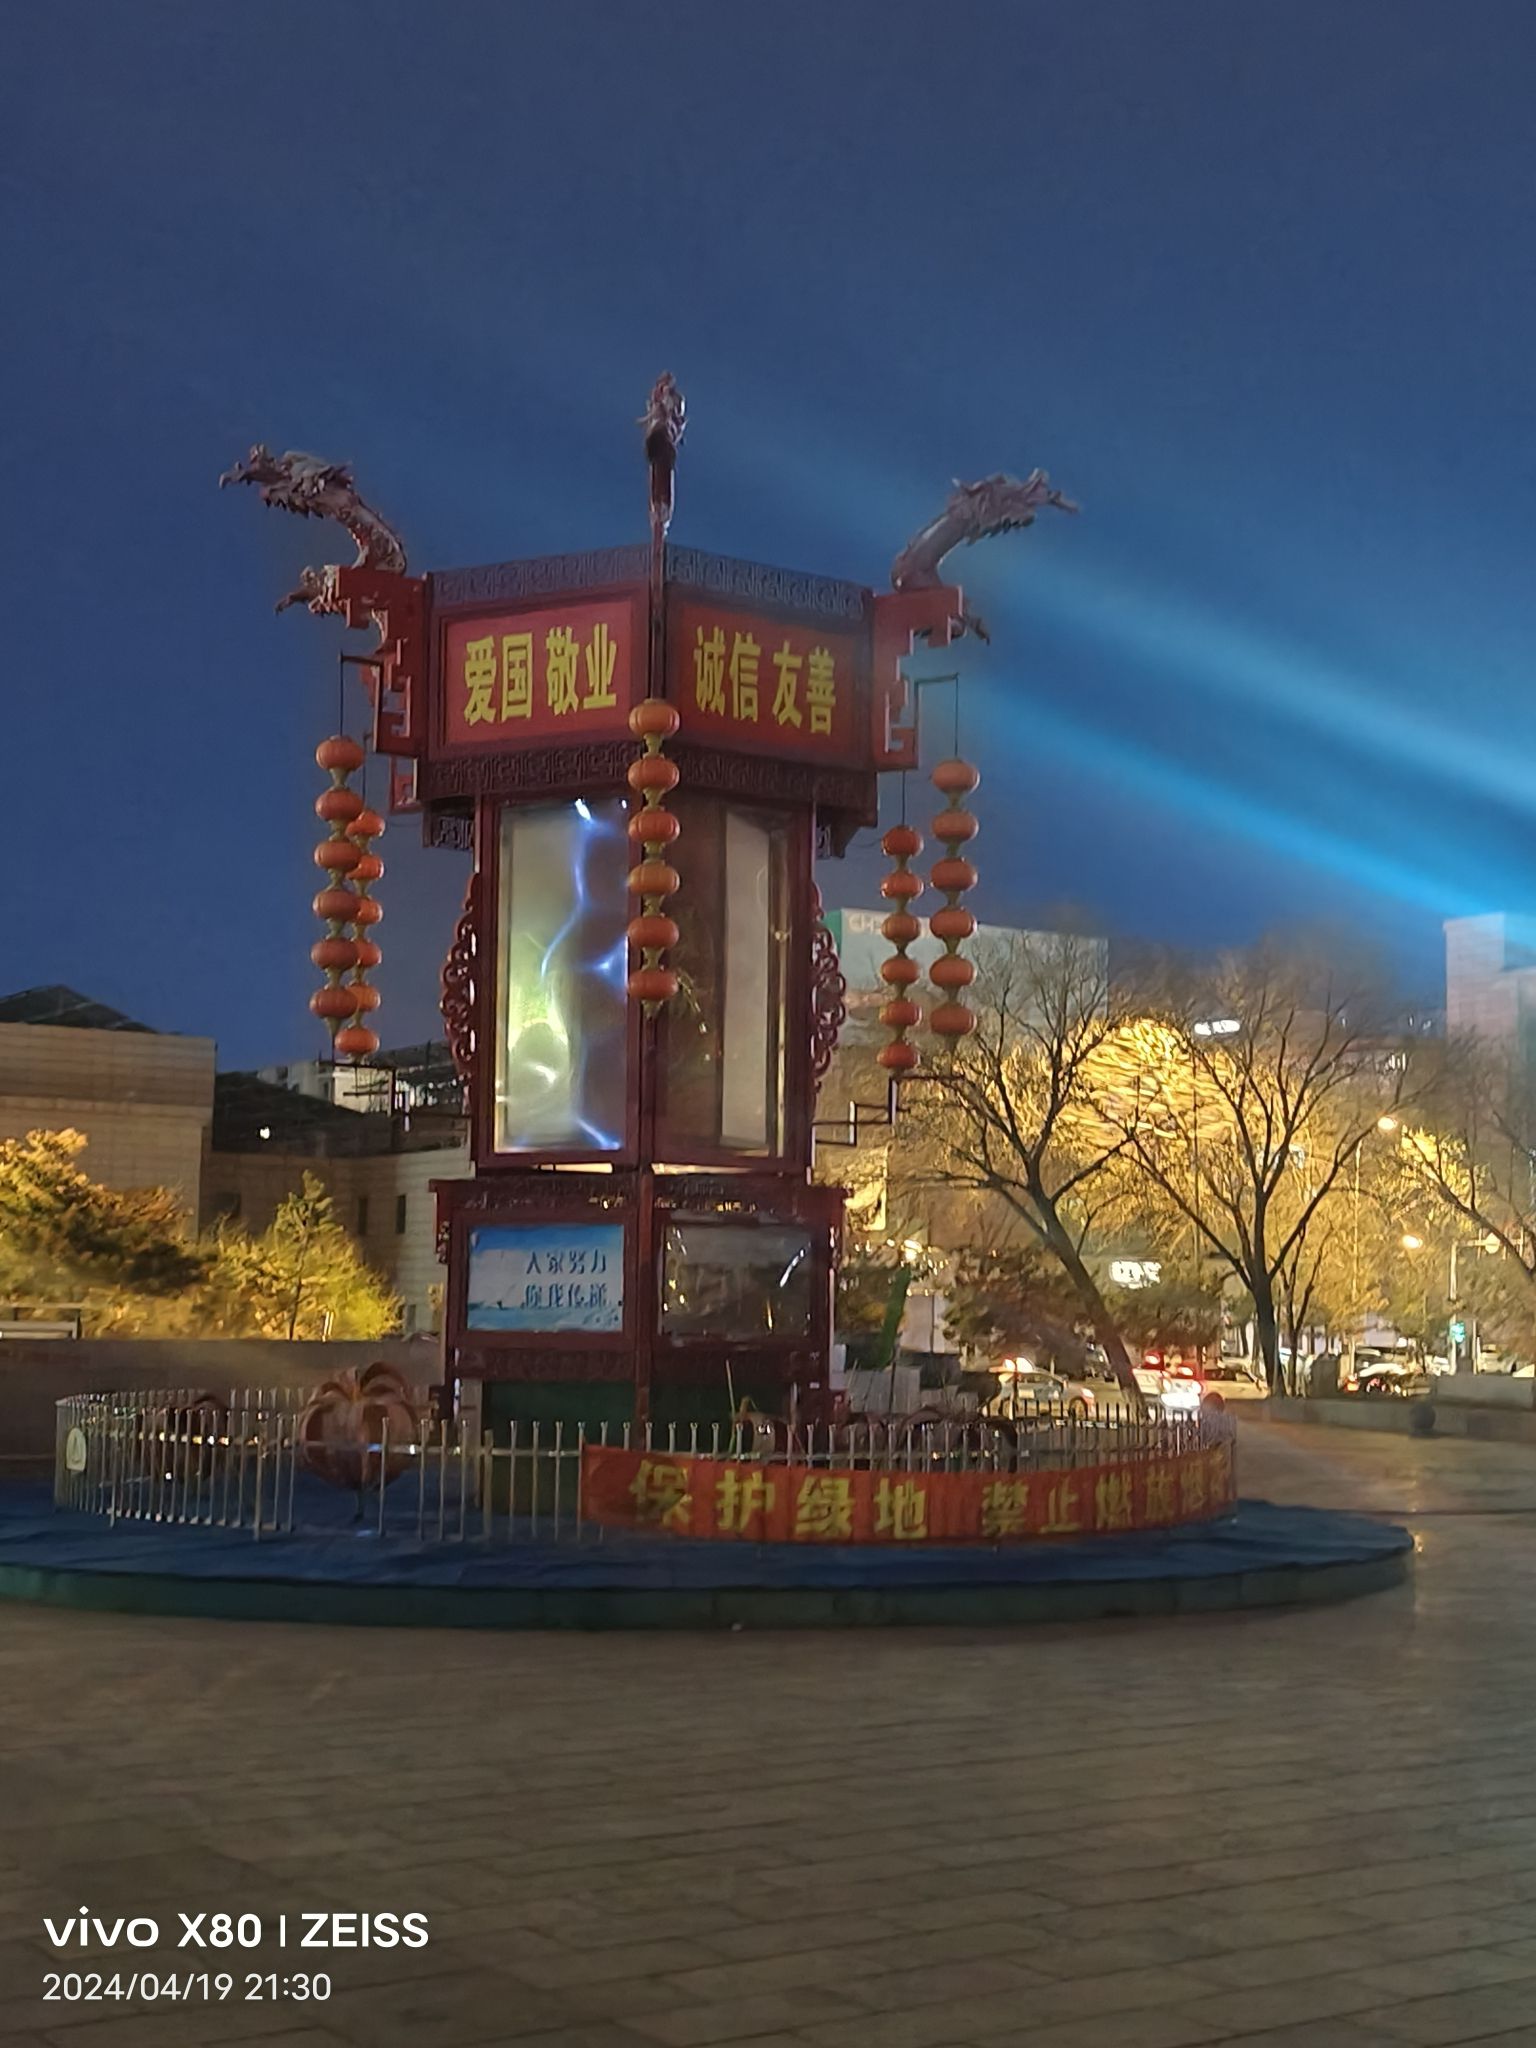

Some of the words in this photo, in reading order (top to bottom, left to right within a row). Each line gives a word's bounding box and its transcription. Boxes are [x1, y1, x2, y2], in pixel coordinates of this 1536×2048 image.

[464, 623, 617, 727] 爱国敬业
[694, 626, 836, 735] 诚信友善
[629, 1460, 927, 1539] 保护绿地
